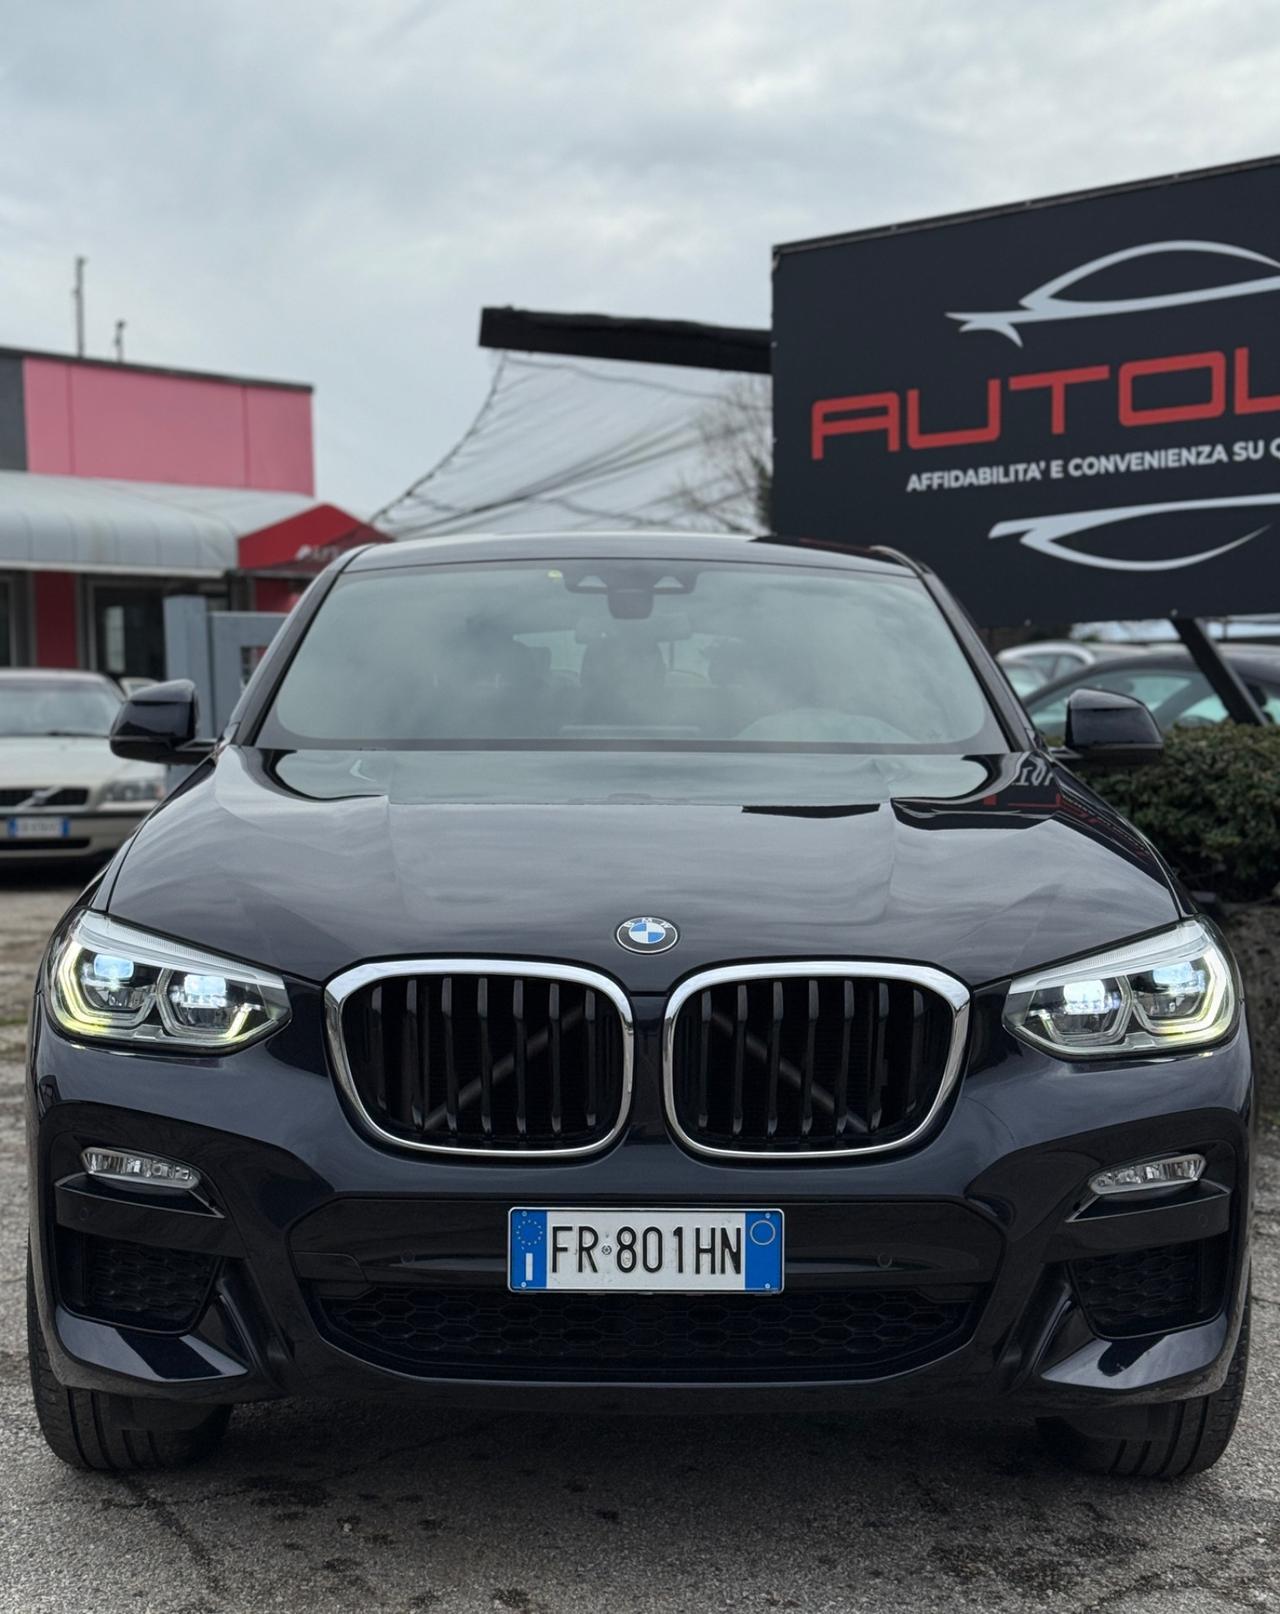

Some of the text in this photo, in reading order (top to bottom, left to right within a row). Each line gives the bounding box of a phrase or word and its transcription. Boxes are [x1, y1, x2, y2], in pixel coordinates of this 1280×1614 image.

[1050, 460, 1064, 479] E
[1068, 443, 1229, 477] CONVENIENZA
[1233, 439, 1265, 462] SU
